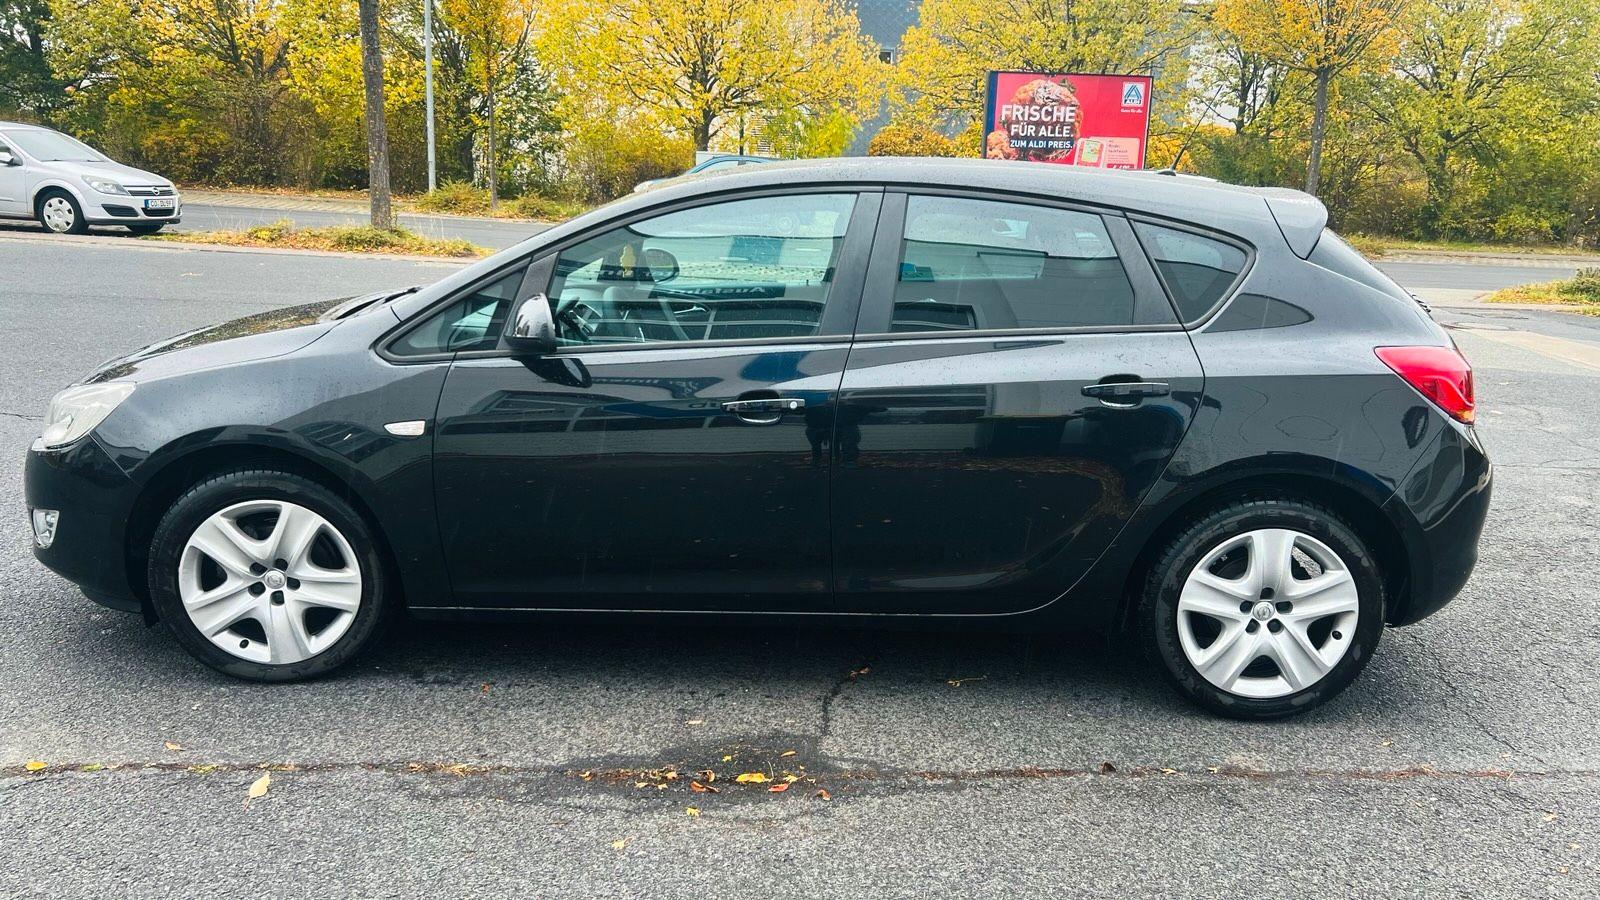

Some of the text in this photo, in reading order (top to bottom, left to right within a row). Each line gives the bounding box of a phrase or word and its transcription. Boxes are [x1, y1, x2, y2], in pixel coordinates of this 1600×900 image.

[1001, 104, 1076, 122] FRISCHE
[1010, 123, 1074, 138] FÜR ALLE.
[1010, 139, 1073, 149] ZUM ALDI PREIS.
